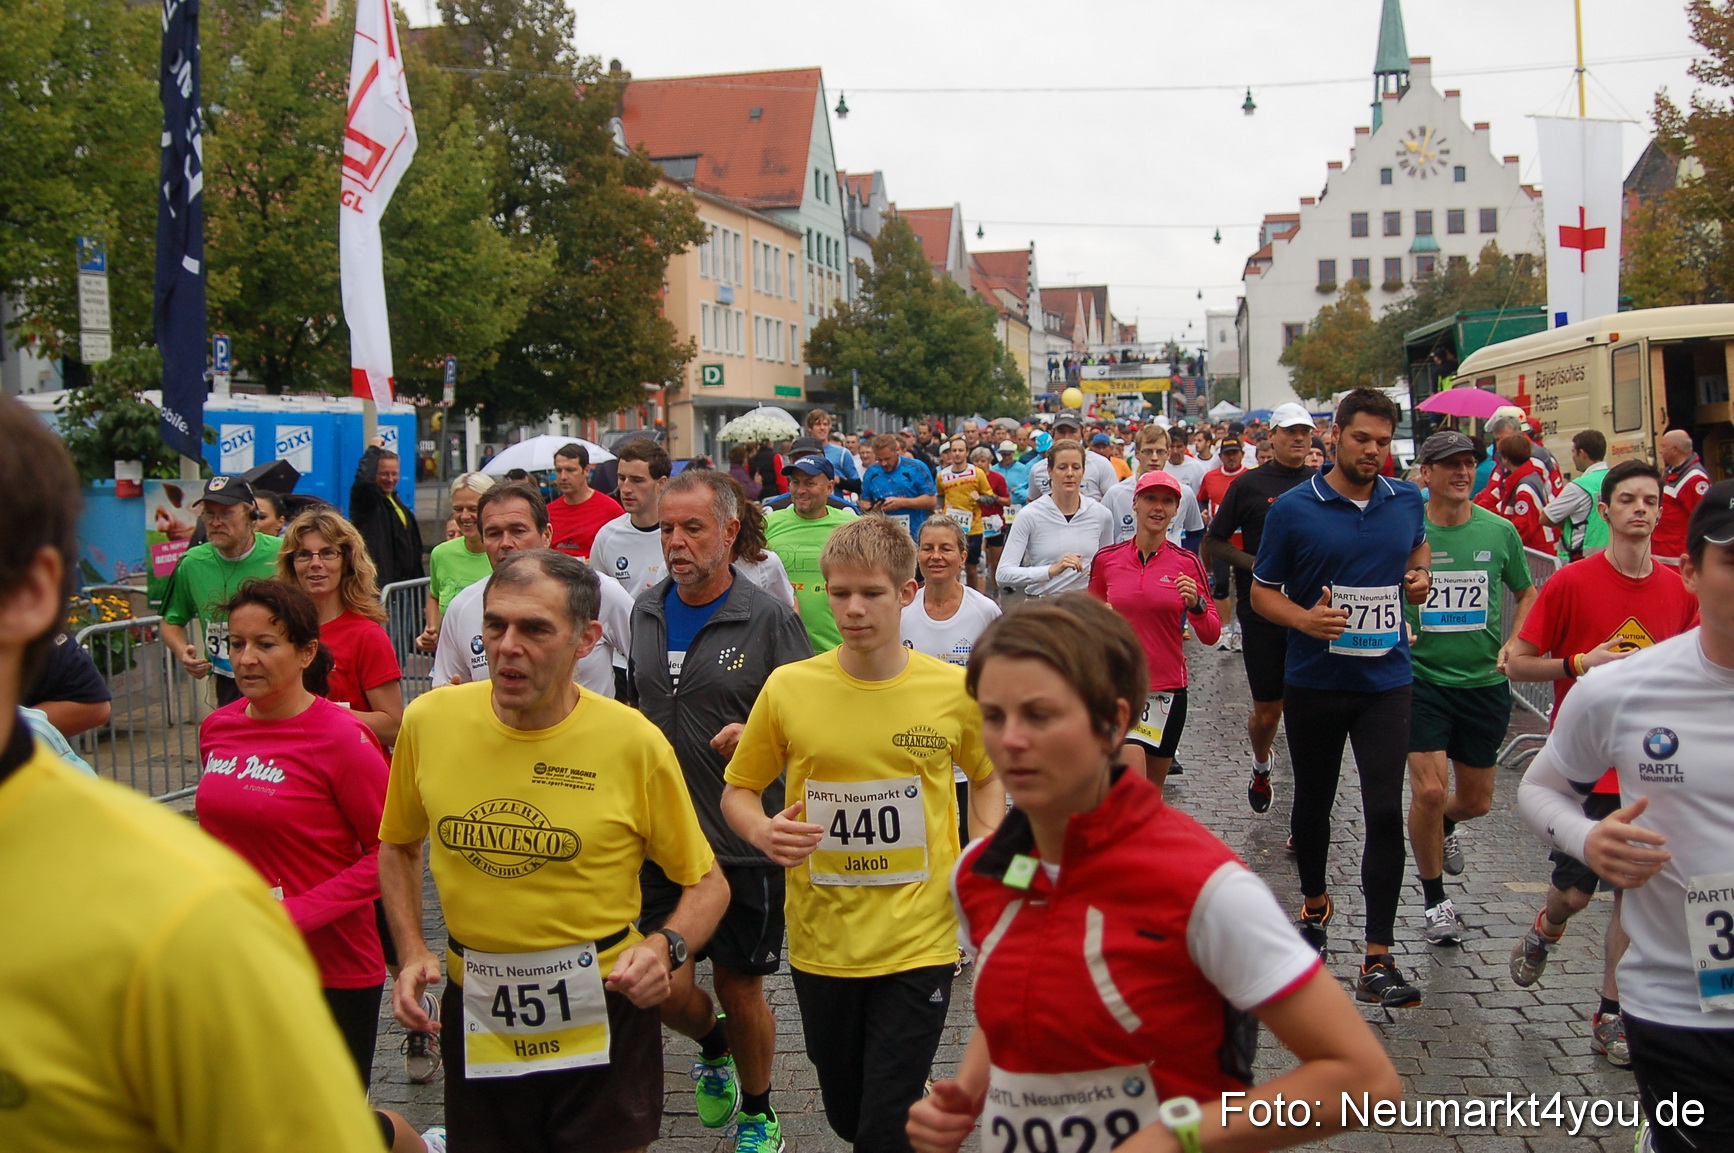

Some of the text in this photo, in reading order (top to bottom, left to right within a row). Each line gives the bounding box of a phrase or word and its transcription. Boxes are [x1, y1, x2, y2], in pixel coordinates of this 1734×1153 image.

[704, 366, 721, 383] D
[1535, 363, 1586, 391] Bayerisches
[1110, 381, 1141, 391] START
[1534, 393, 1559, 412] Rotes
[1538, 418, 1558, 435] reuz
[1333, 592, 1358, 601] PARTL
[1426, 586, 1482, 609] 2172
[1440, 613, 1467, 623] Alfred
[1352, 636, 1383, 647] Stefan
[900, 735, 943, 748] FRANCESCO
[237, 754, 286, 784] Pain
[547, 765, 569, 774] SPORT
[570, 768, 597, 779] WAGNER
[1638, 762, 1684, 775] PARTL
[1640, 773, 1684, 783] Neumarkt
[807, 789, 900, 803] PARTL Neumarkt
[469, 801, 546, 829] PIZZERIA
[829, 805, 900, 845] 440
[452, 822, 561, 856] FRANCESCO
[467, 852, 543, 876] HERSBRUCK
[844, 855, 888, 871] Jakob
[466, 959, 573, 977] PARTL Neumarkt
[491, 978, 571, 1027] 451
[514, 1039, 560, 1057] Hans
[1022, 1084, 1116, 1108] Neumarkt
